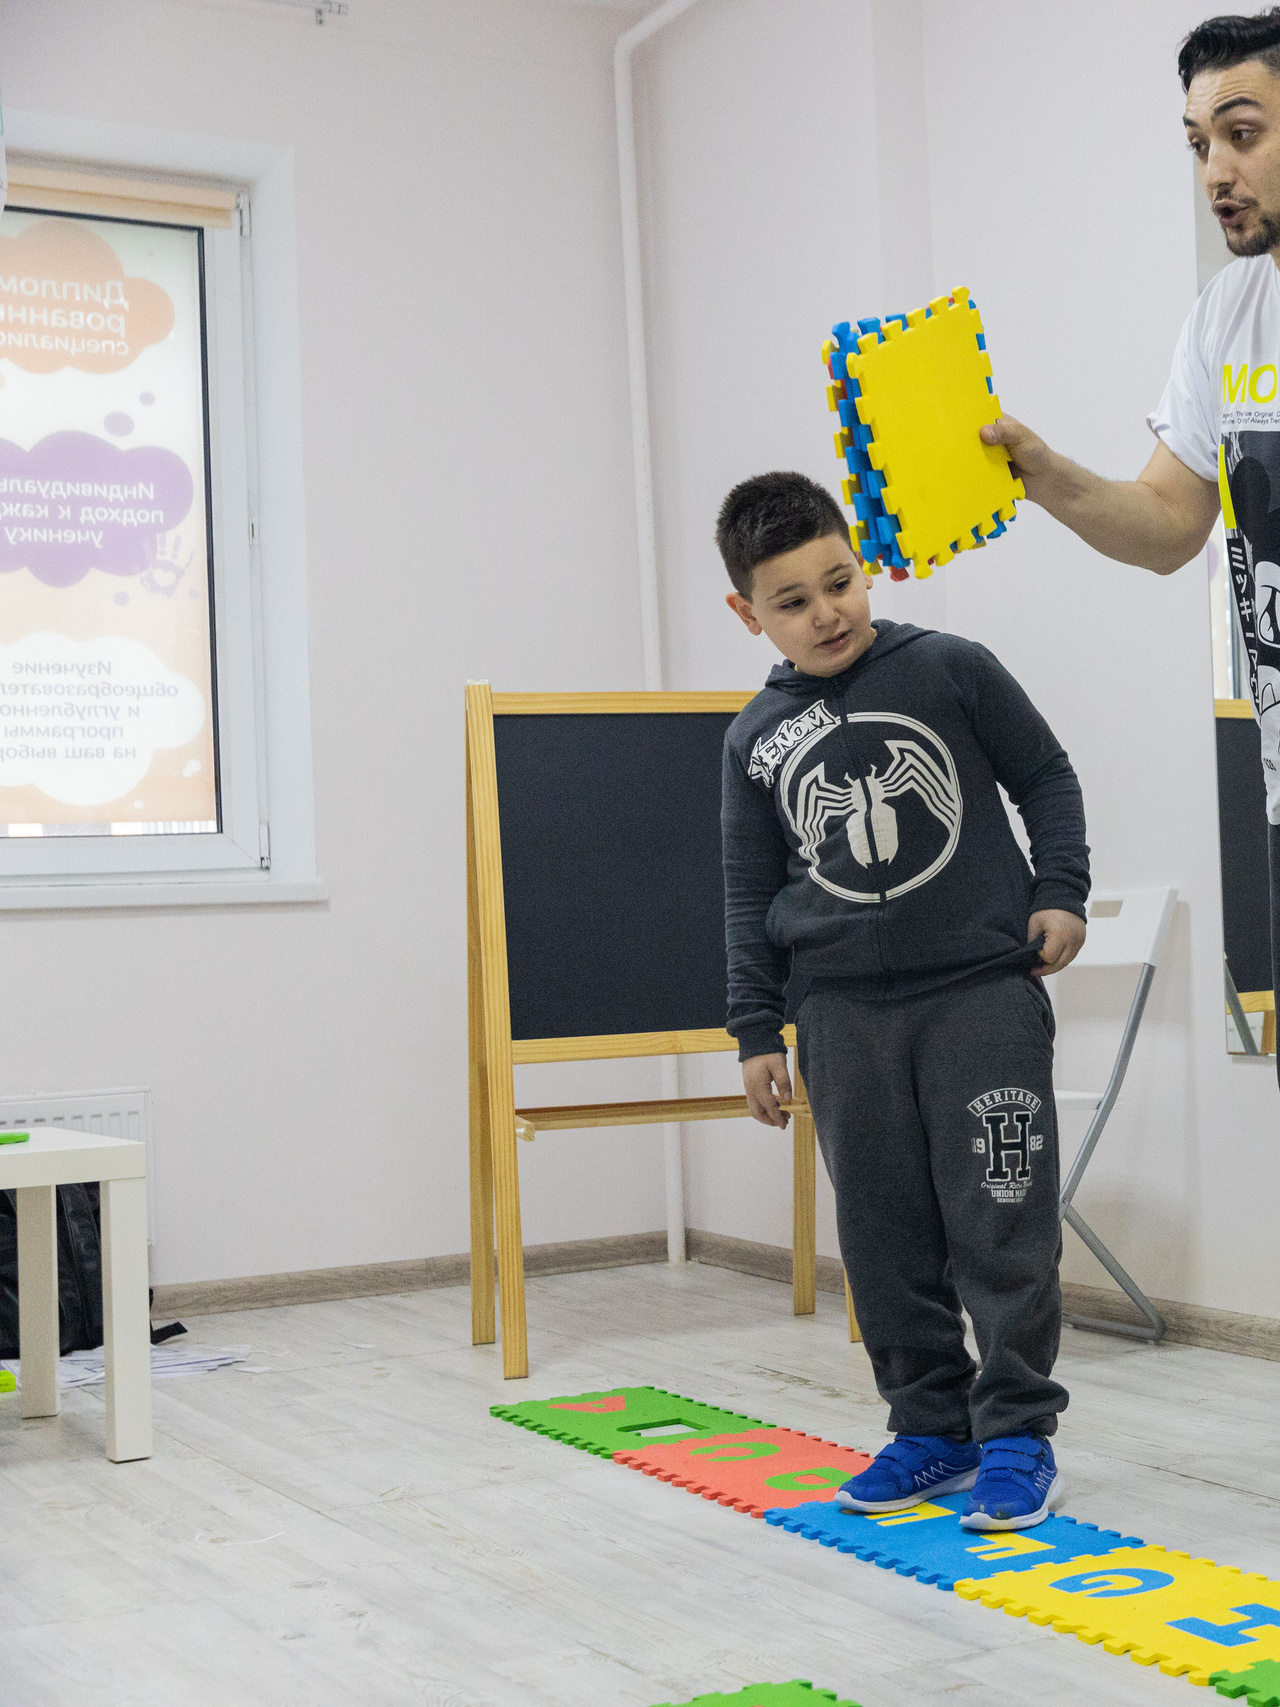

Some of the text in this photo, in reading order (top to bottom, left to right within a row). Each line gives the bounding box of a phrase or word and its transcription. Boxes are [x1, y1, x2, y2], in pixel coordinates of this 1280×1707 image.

[748, 699, 838, 788] VENOM
[973, 1090, 1039, 1112] HERITAGE
[982, 1111, 1032, 1181] H
[980, 1181, 1007, 1189] Original
[991, 1189, 1014, 1198] UNION
